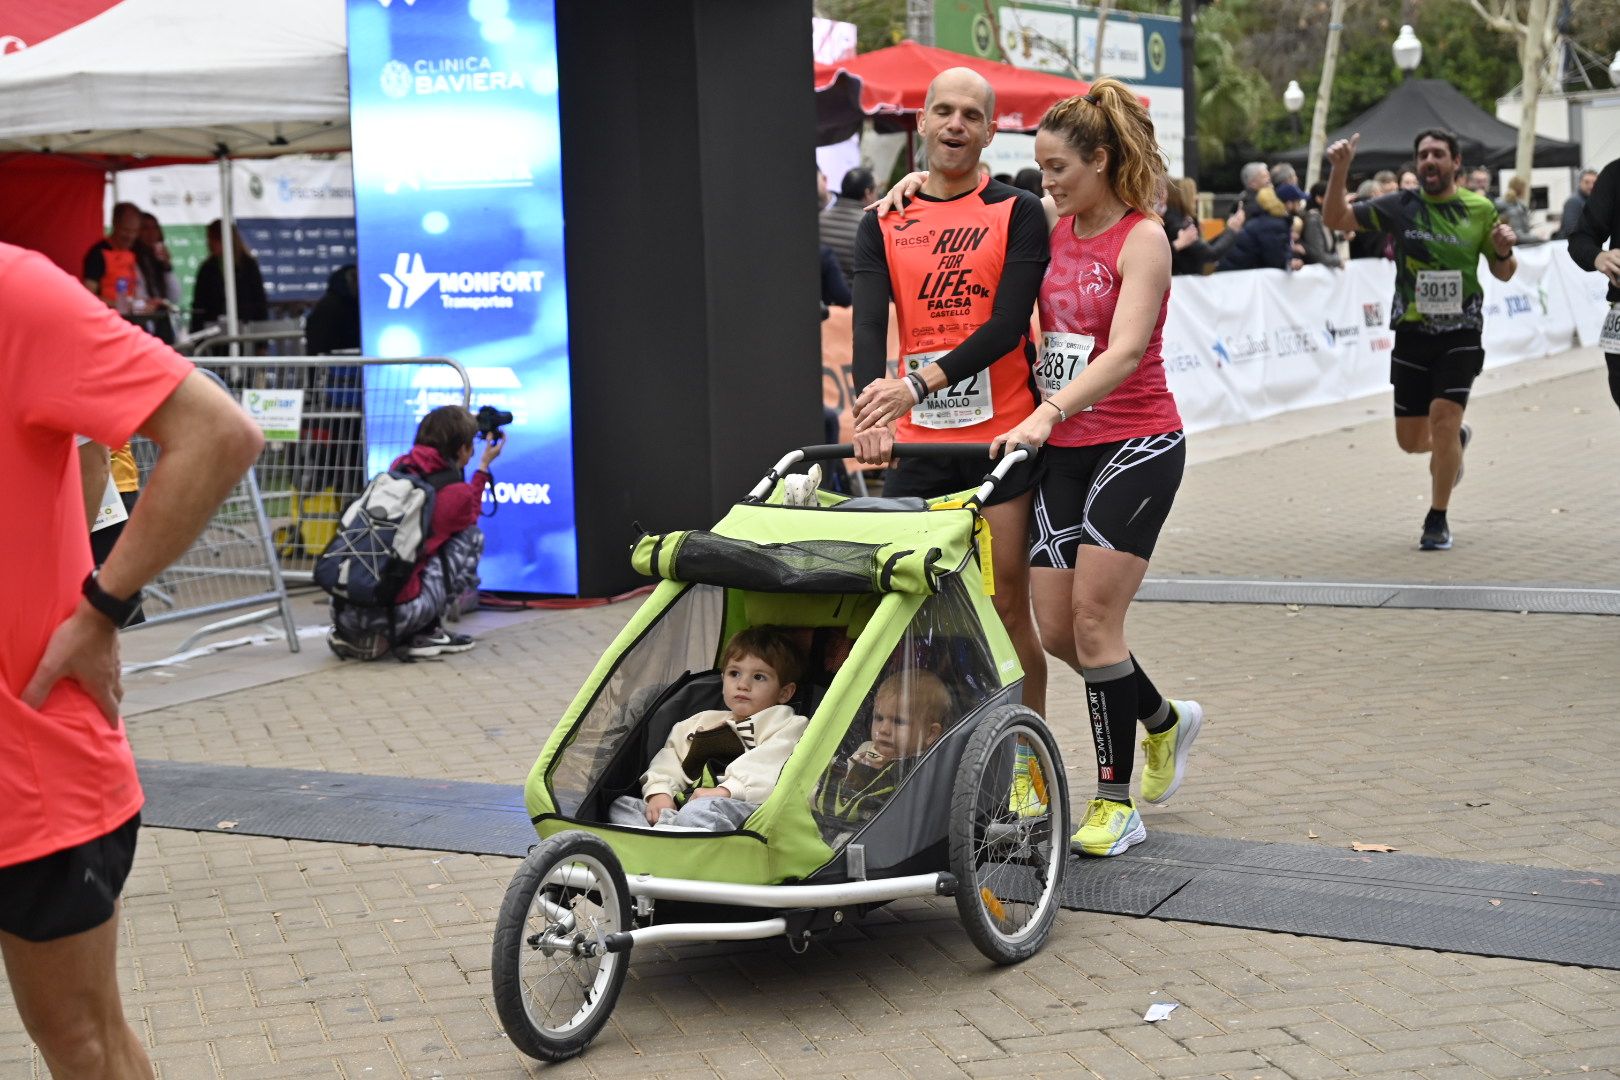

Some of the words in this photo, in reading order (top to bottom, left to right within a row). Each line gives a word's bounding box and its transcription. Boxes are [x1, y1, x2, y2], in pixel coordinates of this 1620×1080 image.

[415, 71, 525, 95] BAVIERA
[932, 227, 989, 255] RUN
[937, 254, 964, 270] FOR
[439, 271, 545, 293] MONFORT
[917, 269, 972, 301] LIFE
[964, 284, 990, 298] 10K
[1421, 282, 1457, 297] 3013
[440, 294, 514, 311] Transportes
[927, 297, 972, 311] FACSA
[930, 308, 970, 318] CASTELLÓ
[927, 398, 970, 409] MANOLO
